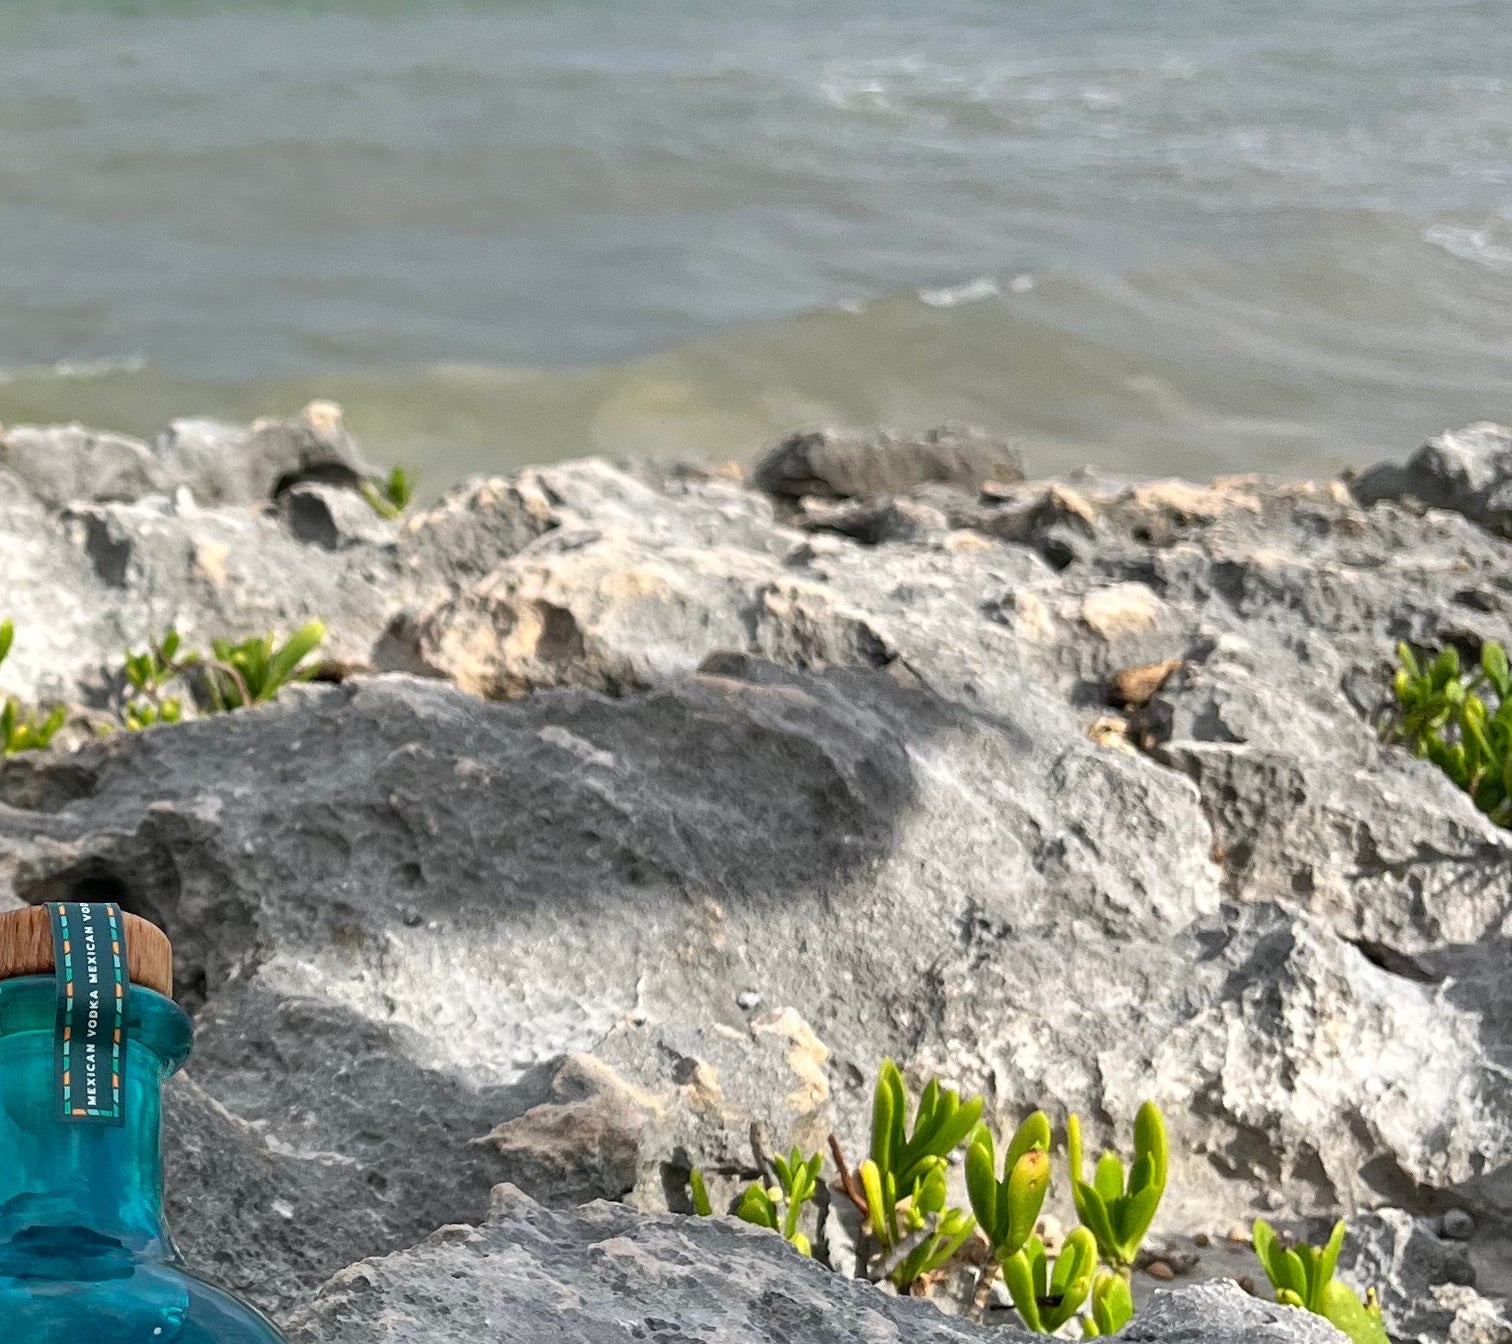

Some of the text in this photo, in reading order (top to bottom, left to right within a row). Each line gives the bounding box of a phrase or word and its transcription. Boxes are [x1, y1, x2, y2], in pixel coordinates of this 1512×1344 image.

[85, 926, 98, 984] MEXICAN
[87, 990, 99, 1038] VODKA
[86, 1044, 97, 1106] MEXICAN
